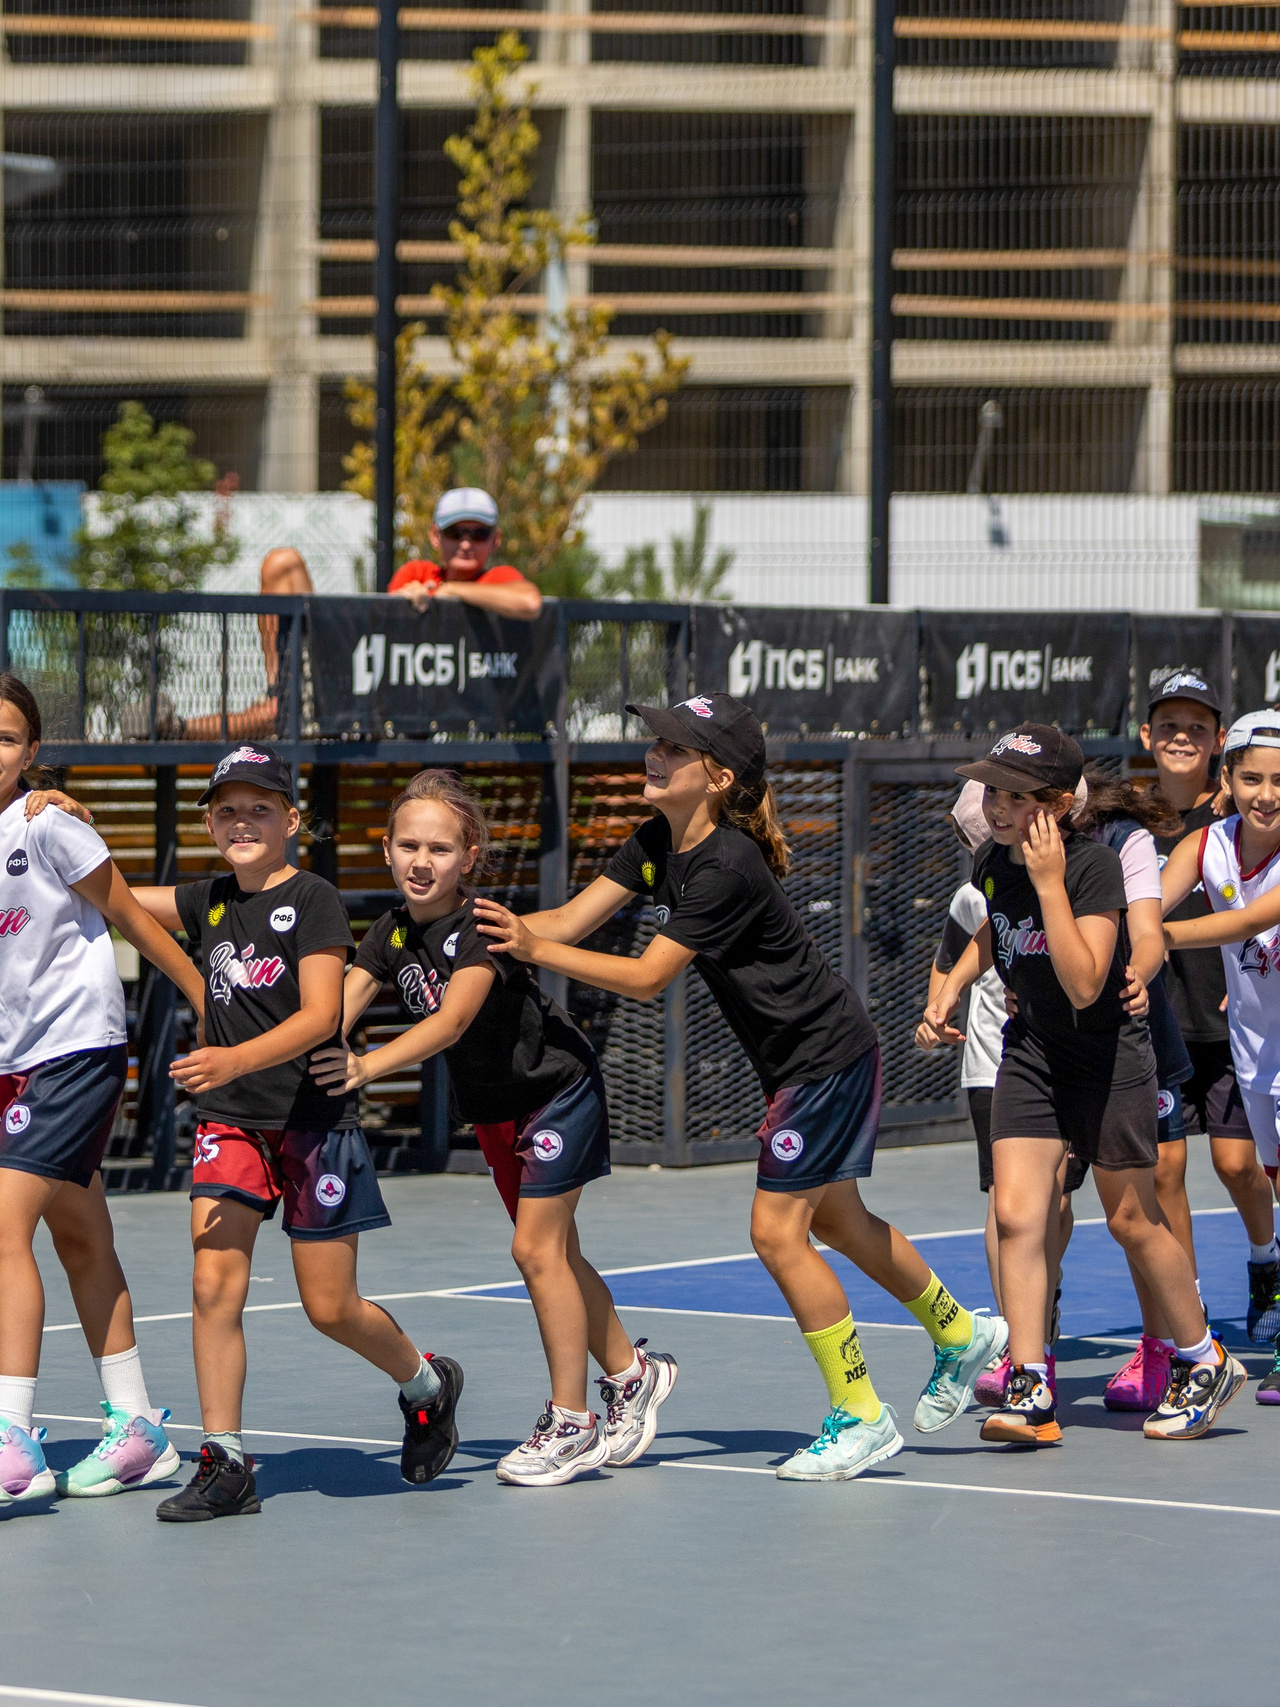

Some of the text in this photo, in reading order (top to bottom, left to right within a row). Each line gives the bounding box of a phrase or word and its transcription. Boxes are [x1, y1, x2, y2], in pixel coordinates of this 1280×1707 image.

[388, 642, 519, 686] ПСБ БАНК
[764, 648, 880, 690] ПСБ БАНК
[989, 650, 1093, 691] ПСБ БАНК
[8, 857, 29, 868] РФБ
[273, 913, 294, 923] РФБ
